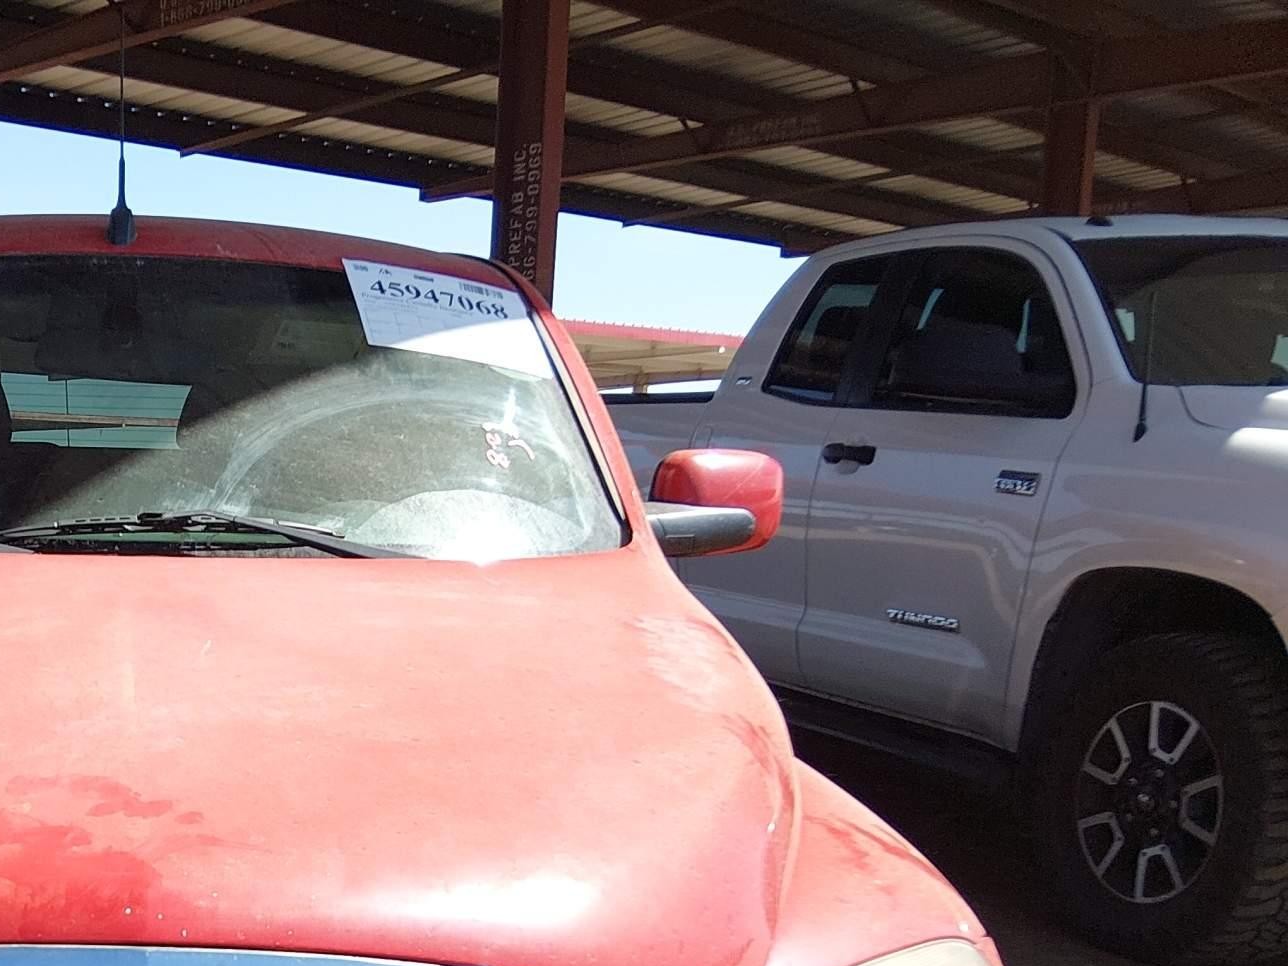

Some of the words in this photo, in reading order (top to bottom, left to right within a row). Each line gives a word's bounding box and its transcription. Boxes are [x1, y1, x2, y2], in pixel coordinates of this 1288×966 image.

[513, 143, 527, 181] INC.
[508, 191, 524, 267] PREFAB
[370, 279, 508, 320] 45947068
